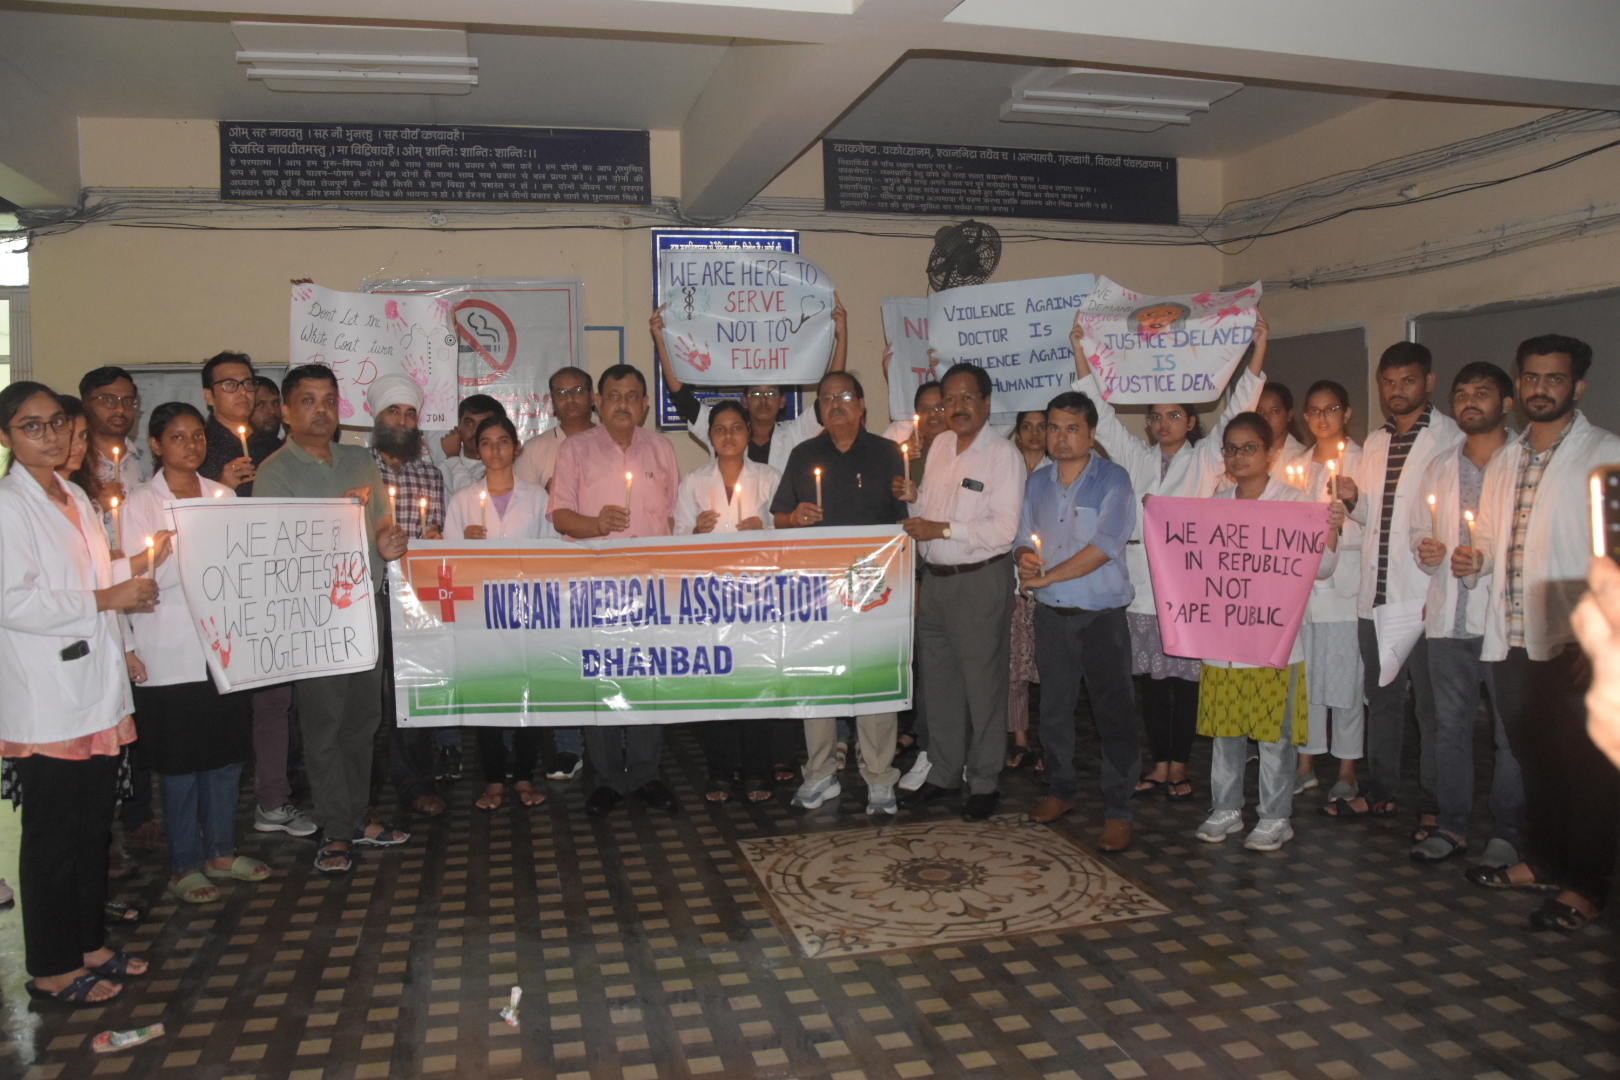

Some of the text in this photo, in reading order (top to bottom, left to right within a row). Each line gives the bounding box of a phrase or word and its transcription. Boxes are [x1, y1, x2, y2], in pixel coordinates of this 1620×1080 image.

[228, 125, 250, 140] ओम्
[252, 128, 267, 138] सह
[313, 129, 329, 139] सह
[383, 130, 398, 140] सह
[336, 145, 348, 155] मा
[402, 144, 424, 158] ओम्
[389, 159, 400, 168] की
[670, 260, 818, 286] WE ARE HERE TO
[724, 290, 786, 312] SERVE
[944, 302, 1016, 322] VIOLENCE
[718, 320, 787, 342] NOT TO
[958, 328, 1009, 346] DOCTOR
[1104, 326, 1254, 350] JUSTICE DELAYED
[732, 348, 789, 370] FIGHT
[1152, 354, 1176, 372] IS
[1182, 373, 1217, 392] DEN
[226, 520, 325, 560] WE ARE
[1166, 521, 1325, 554] WE ARE LIVING
[1185, 550, 1303, 577] IN REPUBLIC
[202, 562, 253, 601] ONE
[1206, 576, 1251, 599] NOT
[438, 588, 454, 600] Dr
[484, 574, 828, 630] INDIAN MEDICAL ASSOCIATION
[224, 594, 332, 638] WE STAND
[1225, 604, 1284, 627] PUBLIC
[247, 626, 363, 675] TOGETHER
[582, 646, 733, 678] DHANBAD
